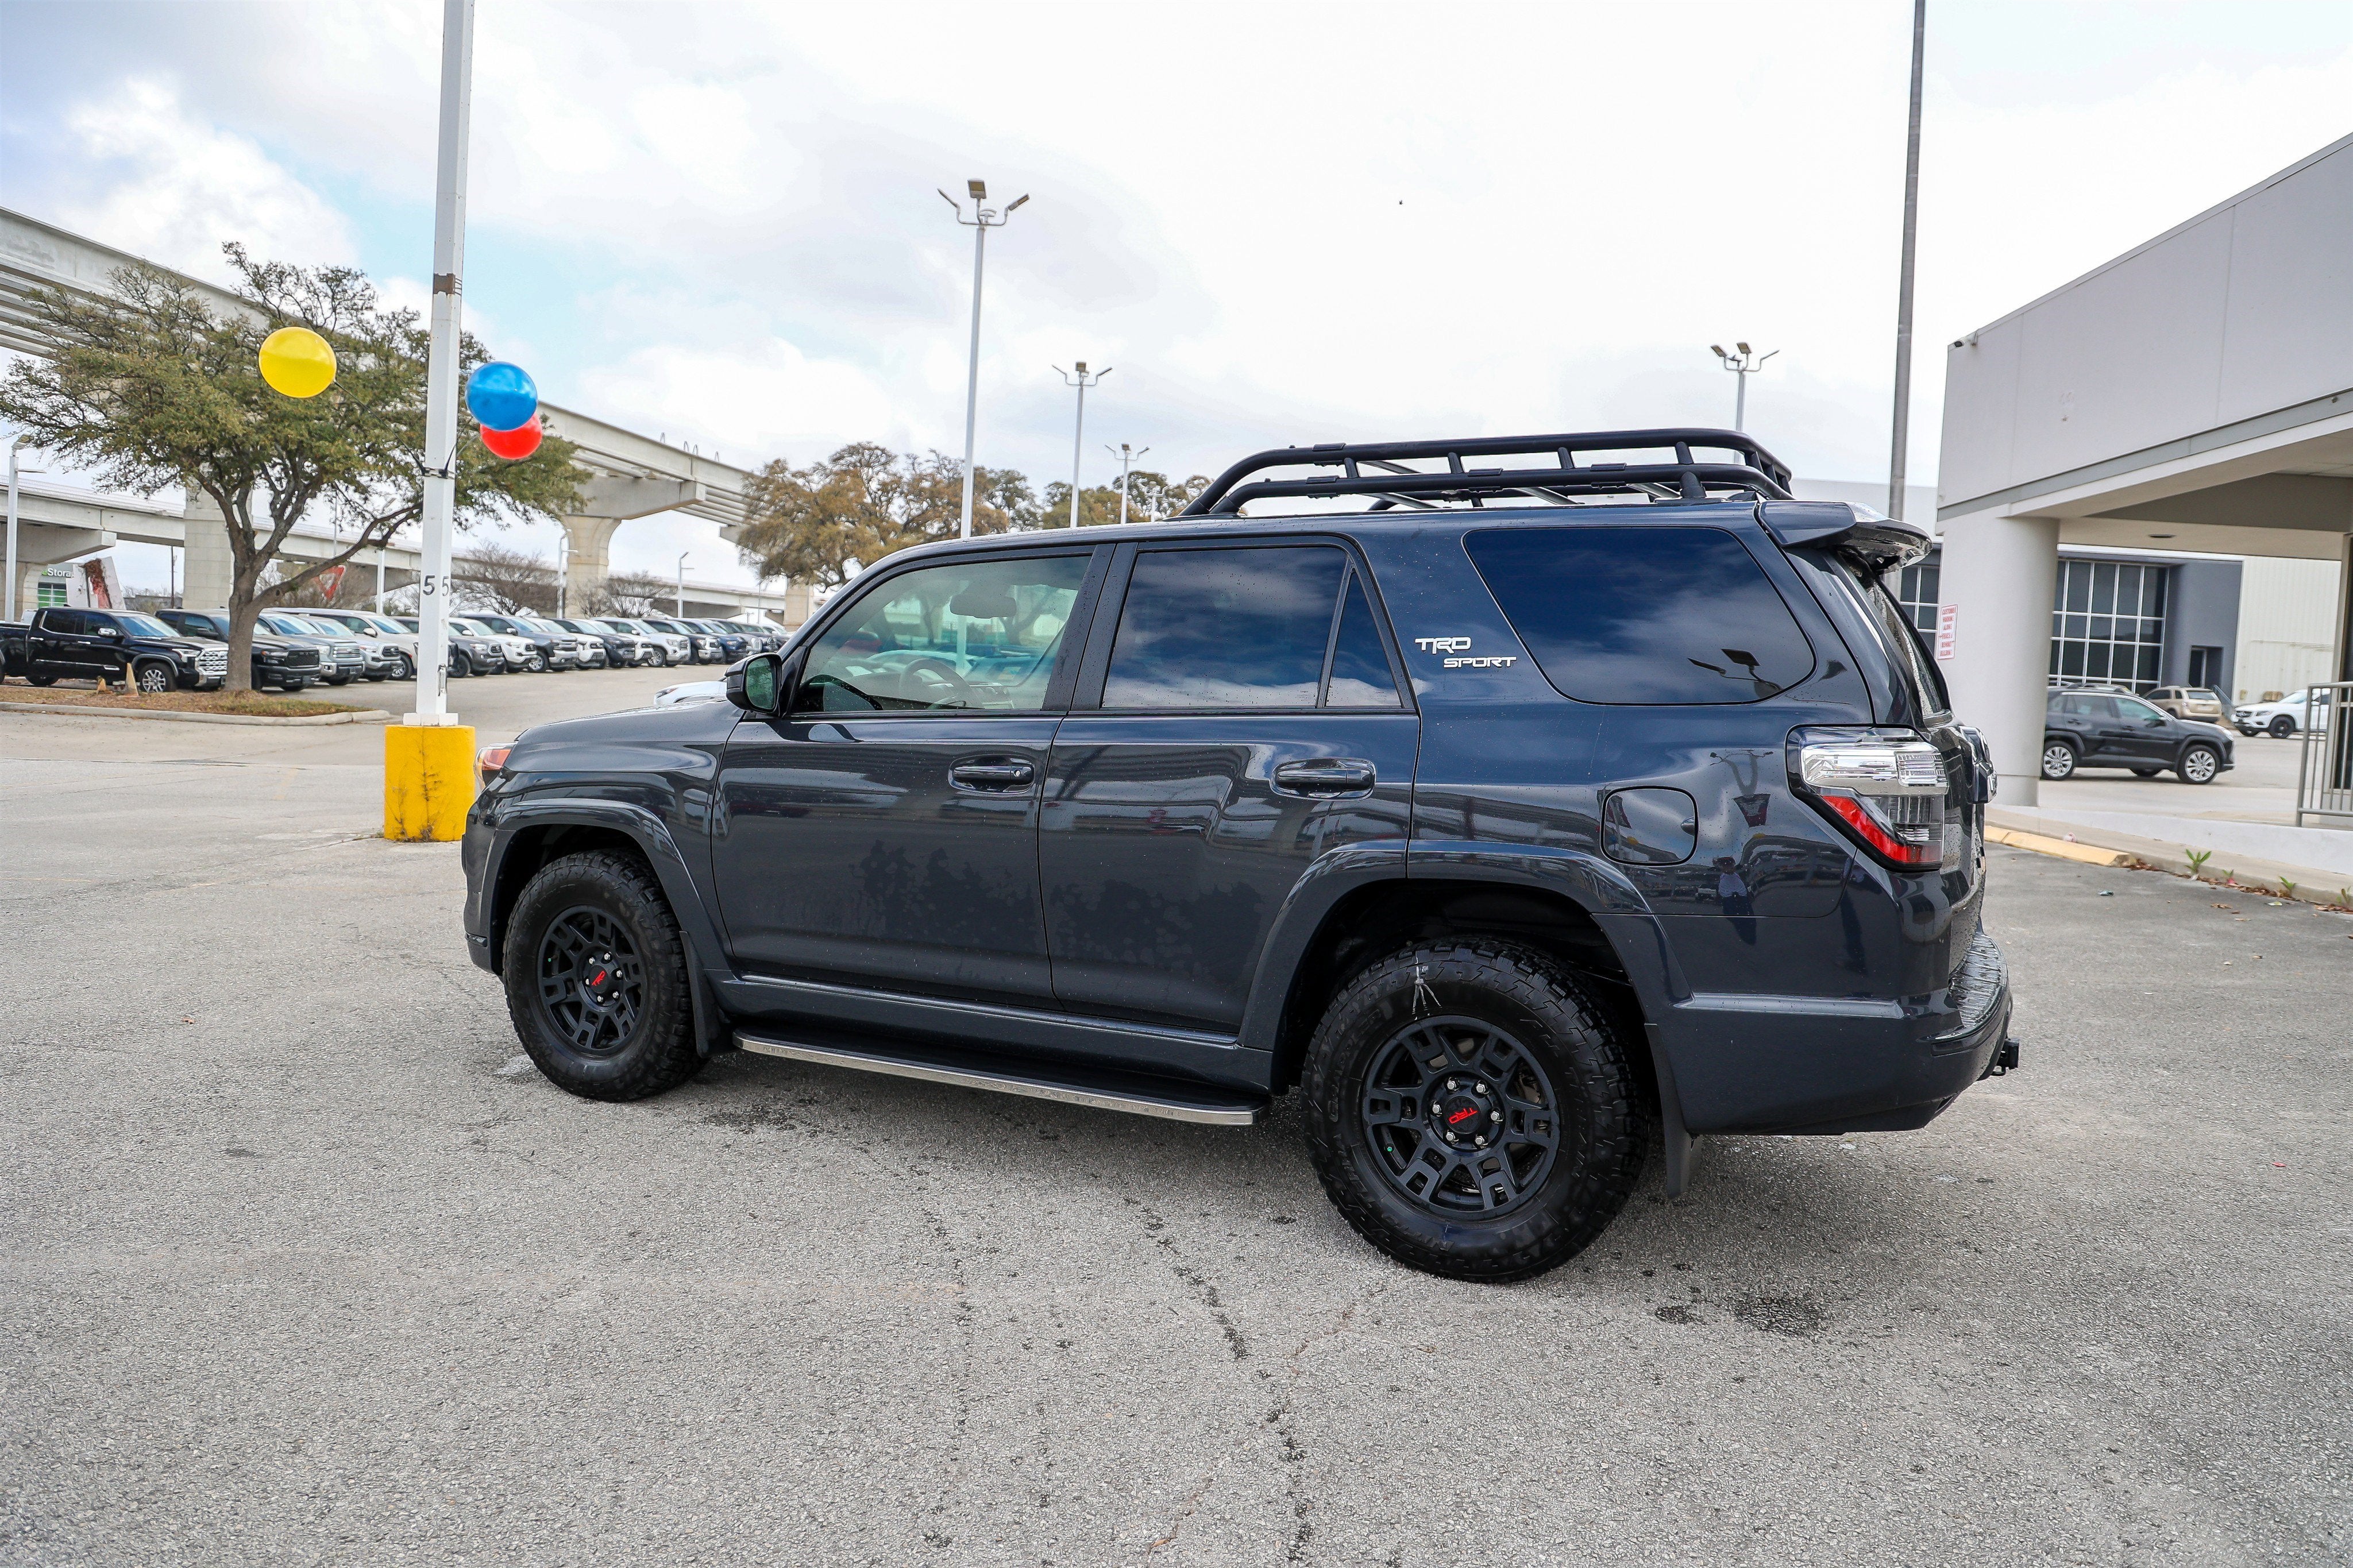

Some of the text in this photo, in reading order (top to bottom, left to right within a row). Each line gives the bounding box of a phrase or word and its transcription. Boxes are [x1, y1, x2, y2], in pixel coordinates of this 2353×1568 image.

[47, 568, 73, 578] Stora
[423, 575, 435, 596] 5
[442, 576, 449, 596] 5
[1415, 637, 1471, 654] TRD
[1444, 656, 1517, 668] SPORT
[592, 971, 605, 986] TRD
[1448, 1107, 1478, 1124] TRD
